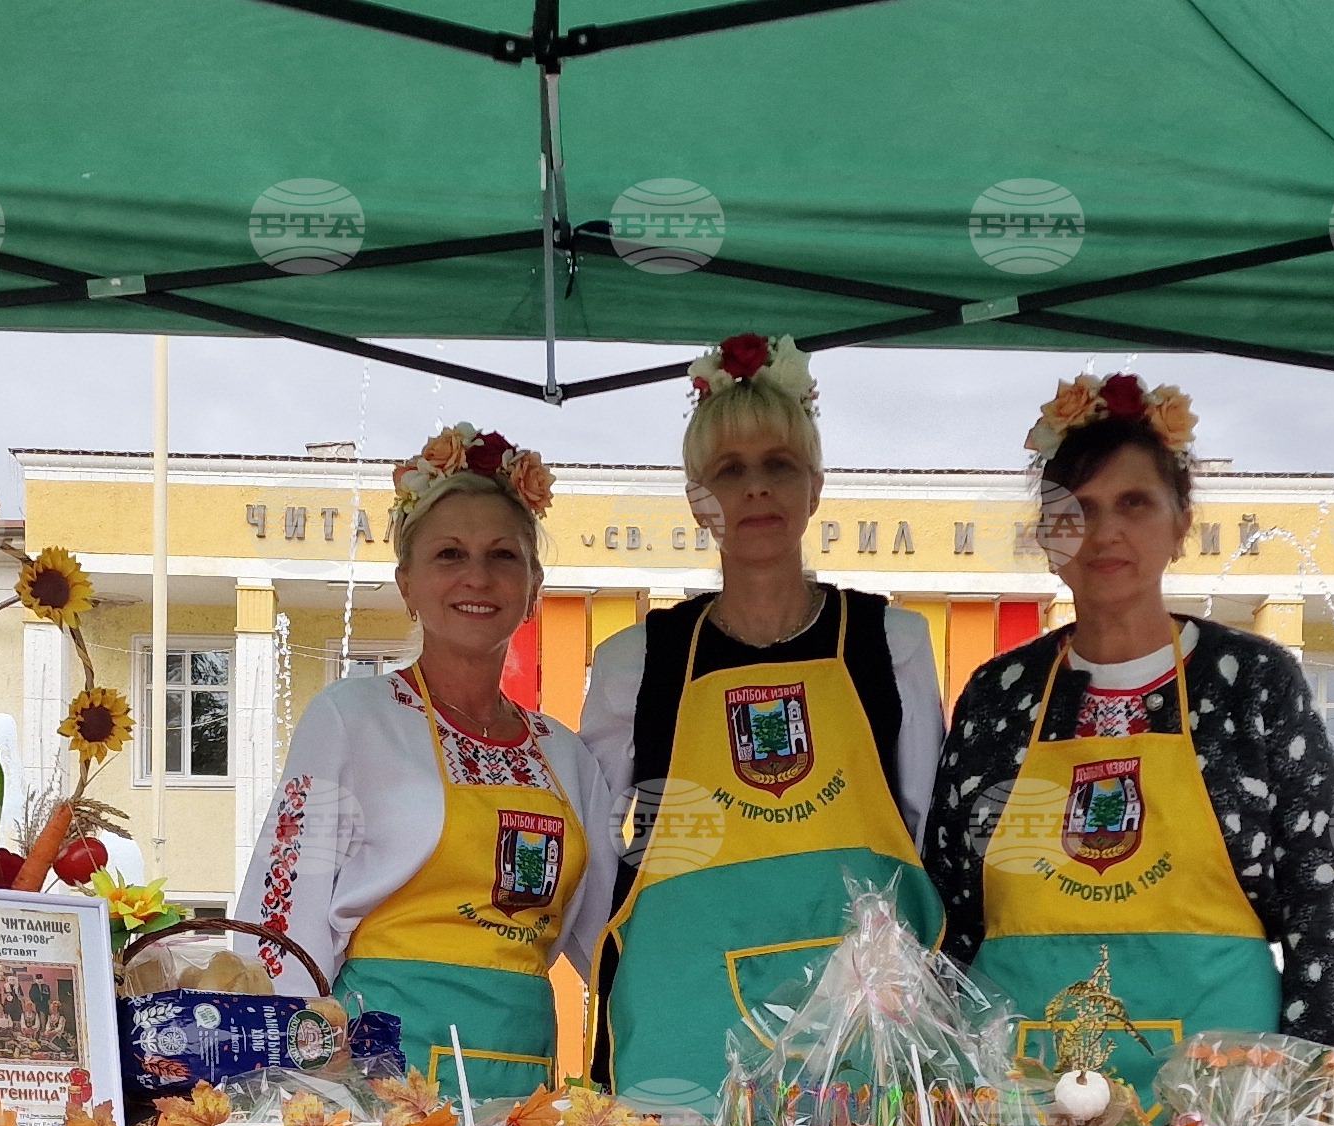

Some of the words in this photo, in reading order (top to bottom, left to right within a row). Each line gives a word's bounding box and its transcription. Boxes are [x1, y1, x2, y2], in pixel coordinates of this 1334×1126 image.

[954, 521, 974, 555] И
[770, 684, 803, 700] ИЗВОР
[1106, 759, 1140, 774] ИЗВОР
[711, 787, 735, 811] НЧ
[537, 818, 563, 834] ИЗВОР
[1033, 857, 1055, 881] НЧ
[1, 917, 72, 935] ЧИТАЛИЩЕ
[250, 1028, 265, 1052] ХЛЯБ
